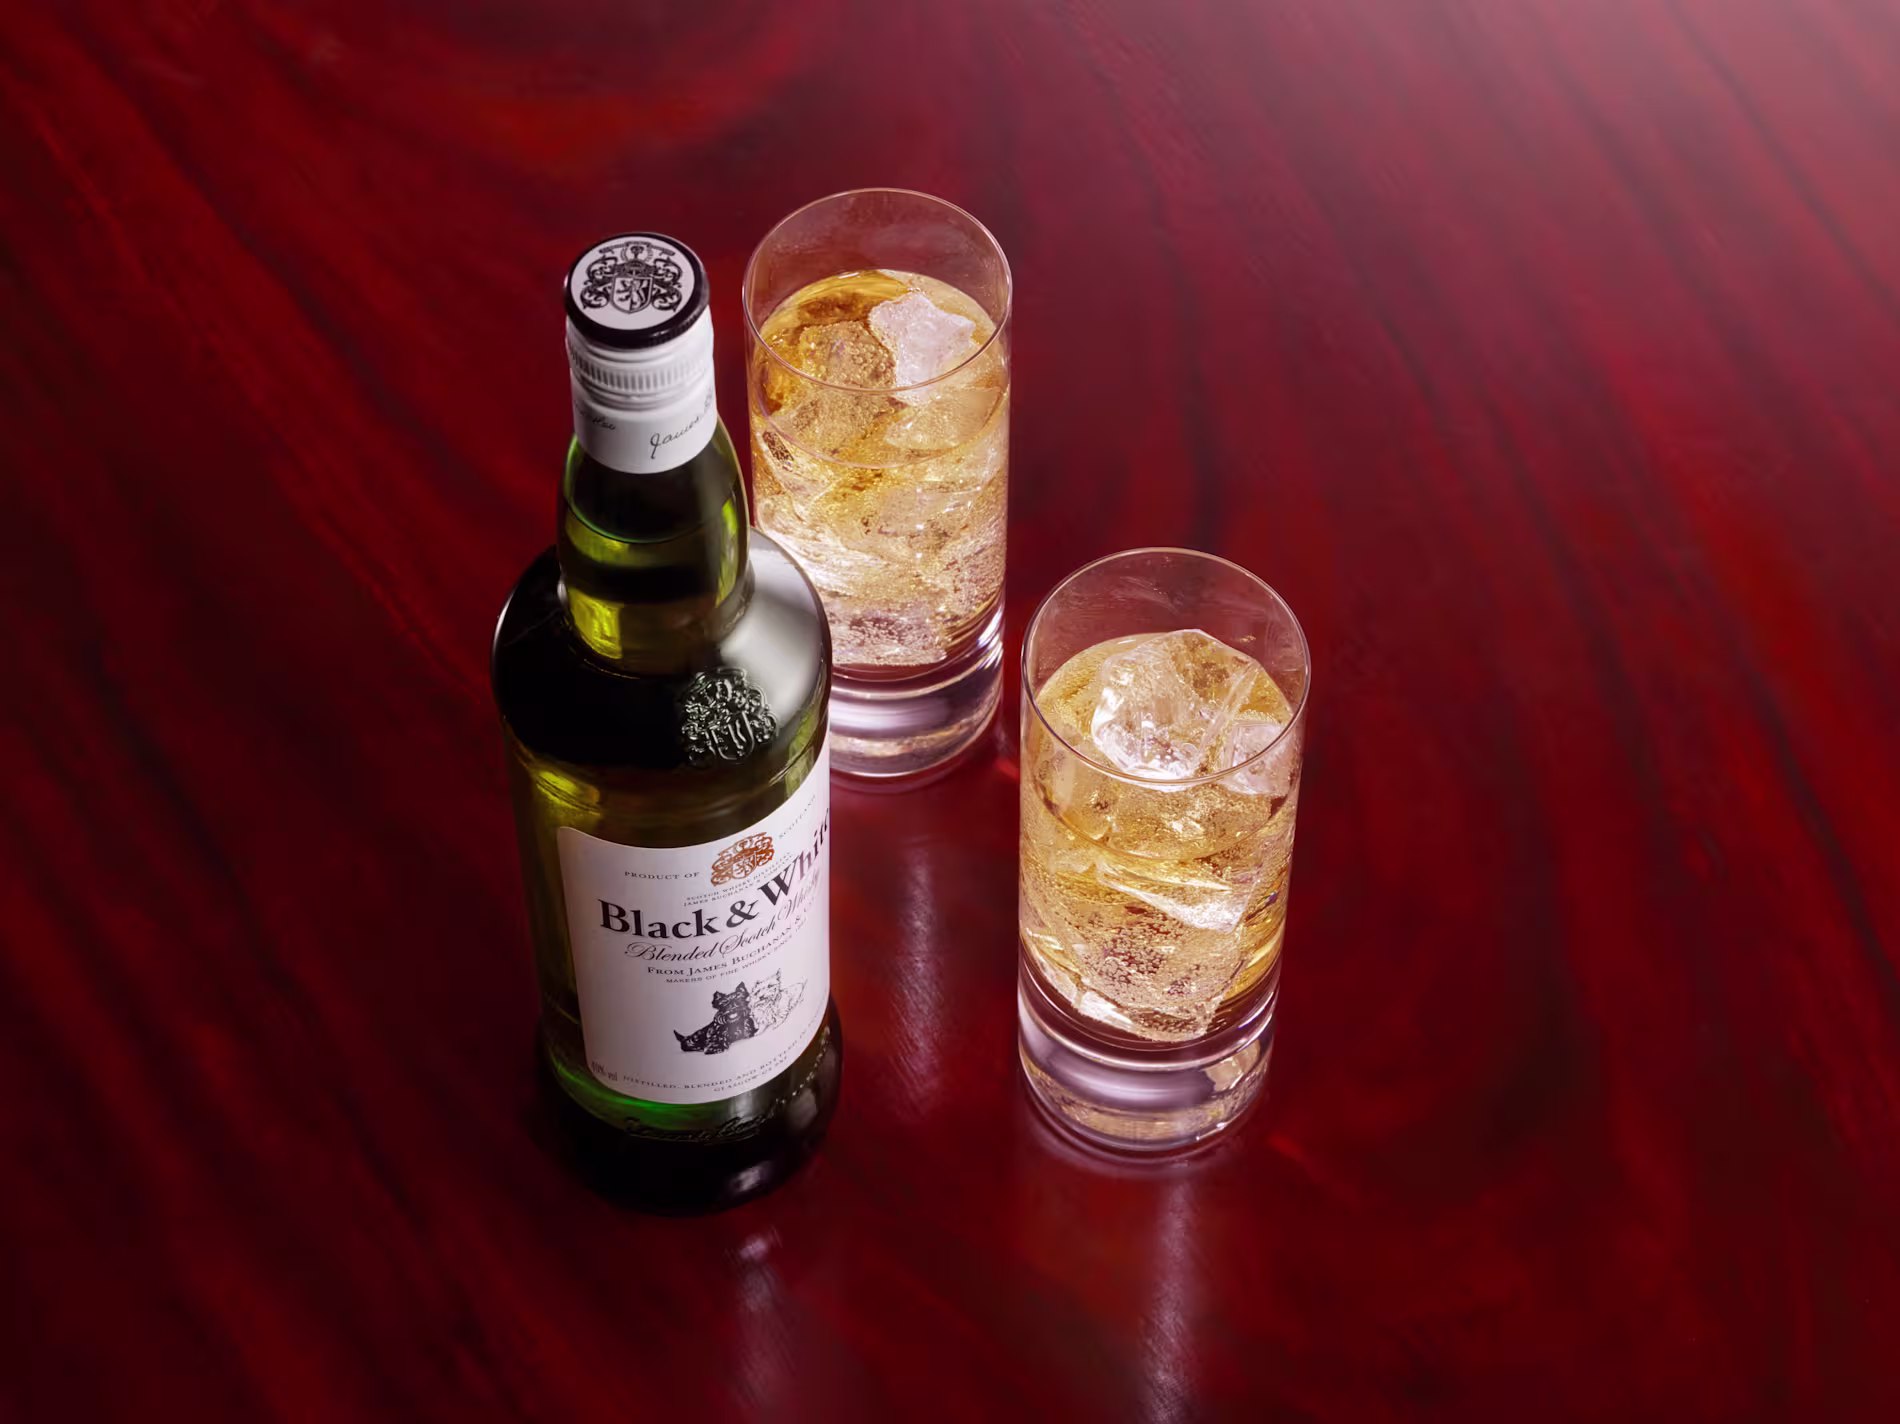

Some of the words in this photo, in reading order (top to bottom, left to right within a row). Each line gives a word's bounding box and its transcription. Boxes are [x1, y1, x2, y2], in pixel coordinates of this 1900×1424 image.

[624, 871, 680, 880] PRODUCT
[684, 871, 701, 879] OF
[687, 891, 720, 900] SCOTCH
[722, 877, 751, 893] WHISKY
[684, 898, 709, 907] JAMES
[711, 881, 753, 902] BUCHANAN
[597, 898, 721, 939] Black
[726, 900, 760, 928] &
[624, 941, 720, 962] Blended
[719, 914, 776, 958] Scotch
[647, 966, 684, 976] FROM
[686, 962, 728, 977] JAMES
[731, 926, 792, 965] BUCHANAN
[705, 973, 717, 981] OF
[720, 967, 739, 977] FINE
[742, 952, 771, 970] WHISKY
[684, 1078, 732, 1089] BLENDED
[736, 1068, 757, 1081] AND
